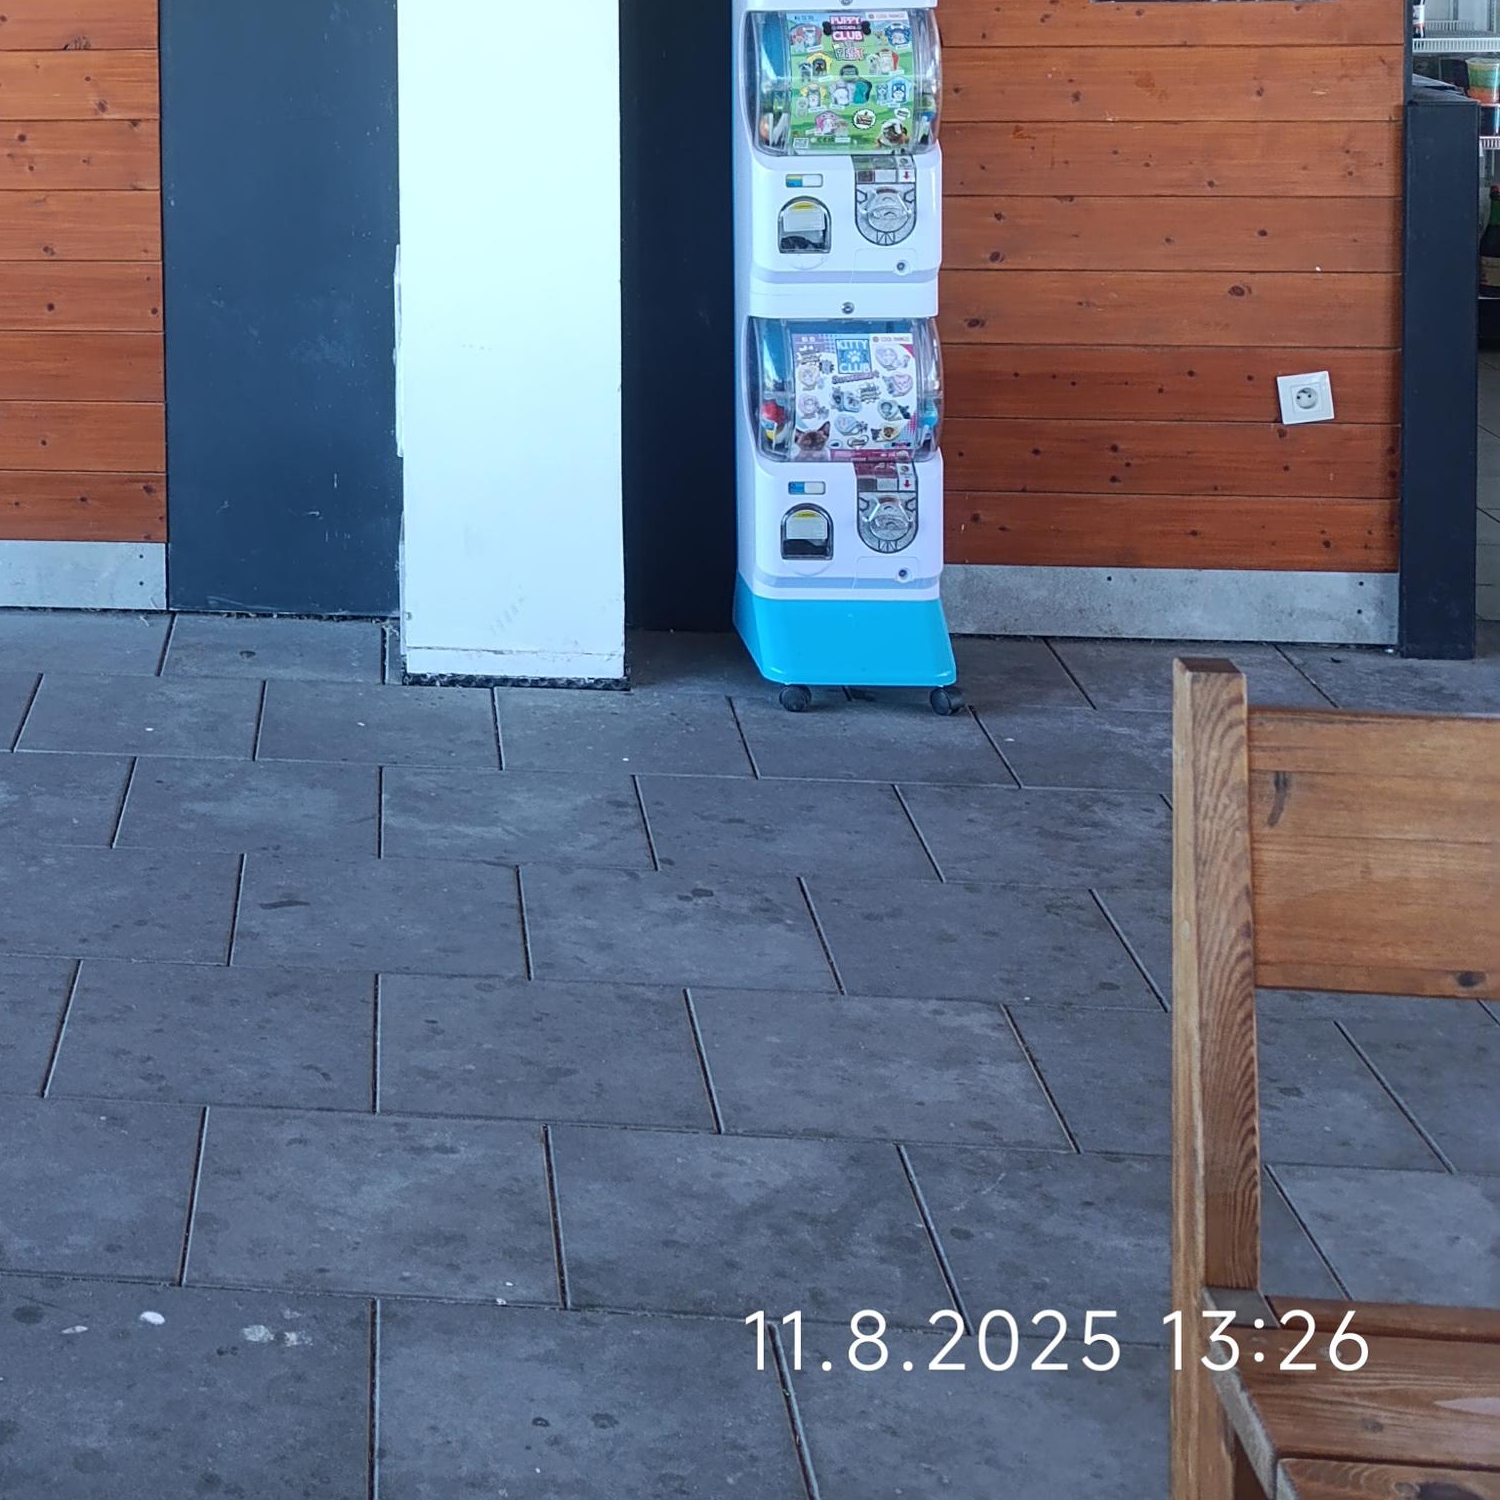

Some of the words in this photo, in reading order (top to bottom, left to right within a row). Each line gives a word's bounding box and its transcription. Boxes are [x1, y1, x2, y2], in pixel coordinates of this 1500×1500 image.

[830, 15, 861, 25] PUPPY
[832, 30, 864, 41] CLUB
[837, 339, 869, 350] KITTY
[839, 362, 870, 374] CLUB
